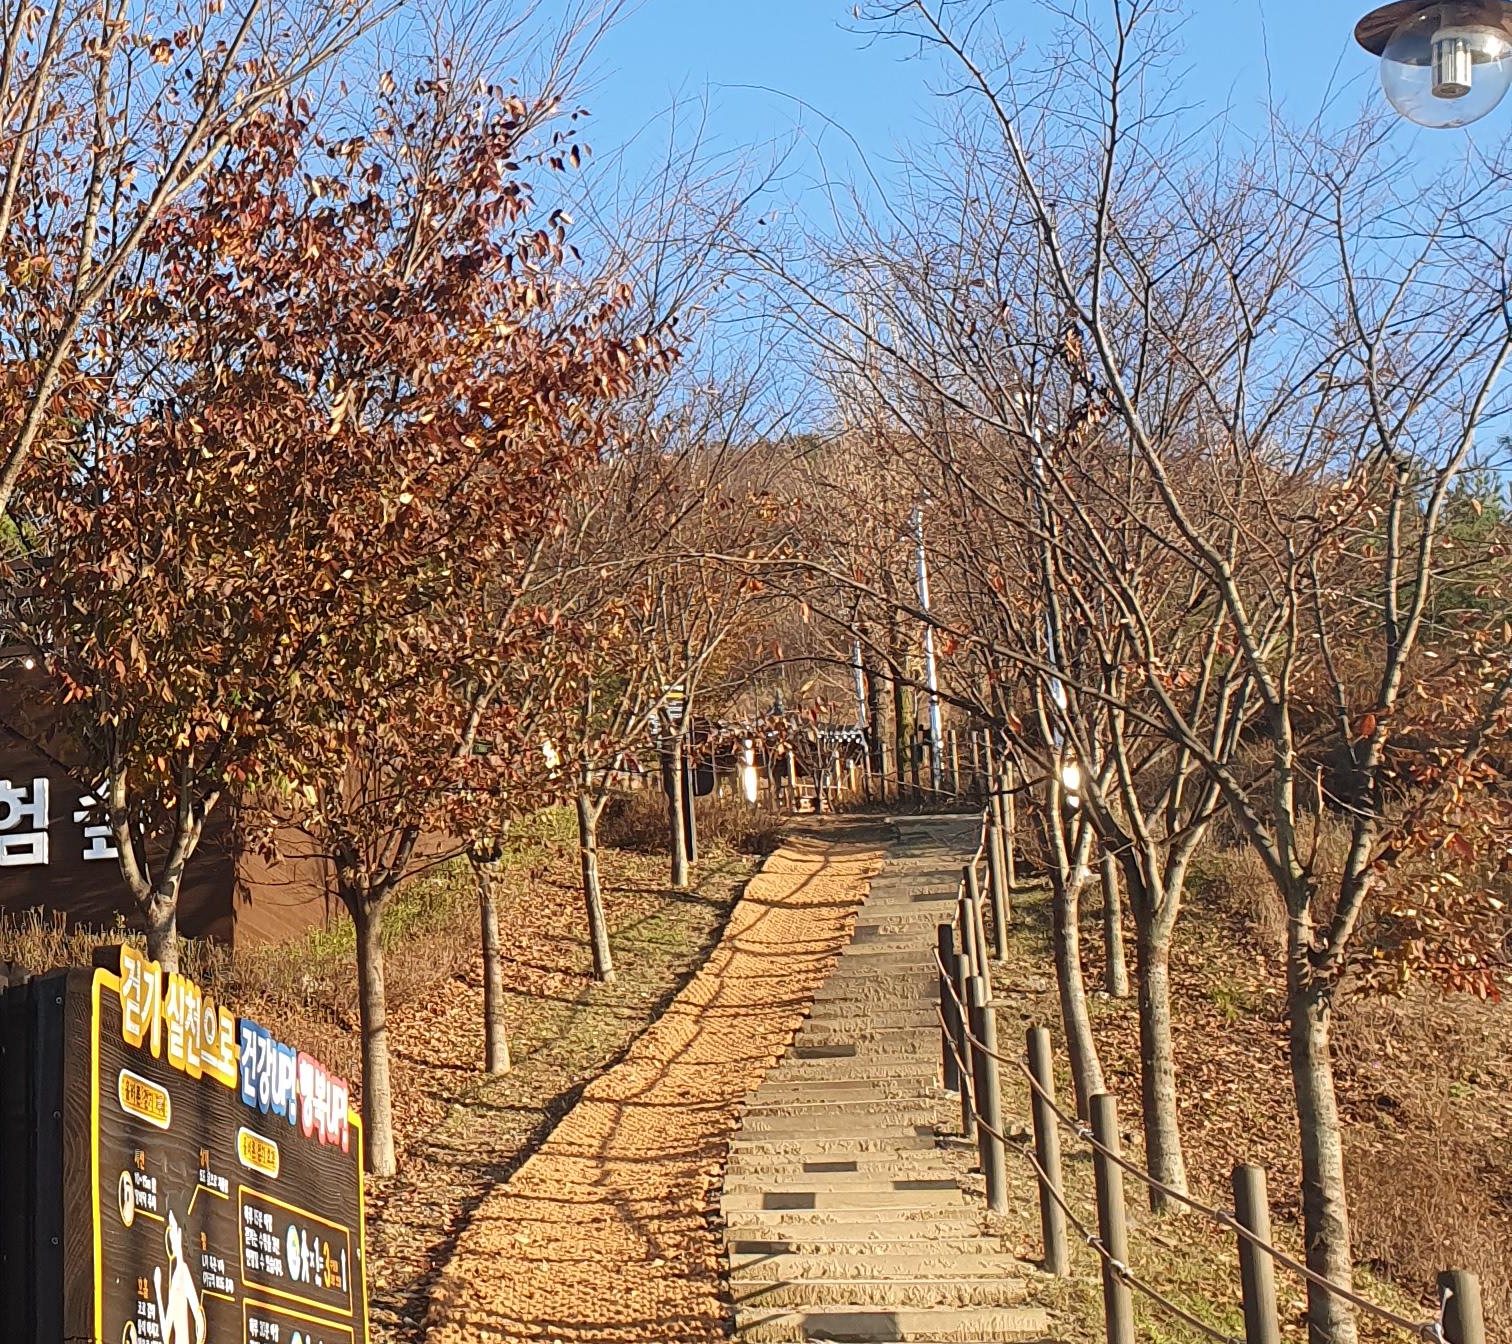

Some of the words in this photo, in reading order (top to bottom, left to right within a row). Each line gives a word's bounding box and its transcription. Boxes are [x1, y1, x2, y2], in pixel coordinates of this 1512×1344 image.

[123, 955, 161, 1053] 걷기
[166, 981, 237, 1077] 실천으로
[241, 1027, 296, 1110] 건강UP!
[299, 1062, 348, 1146] 행복UP!
